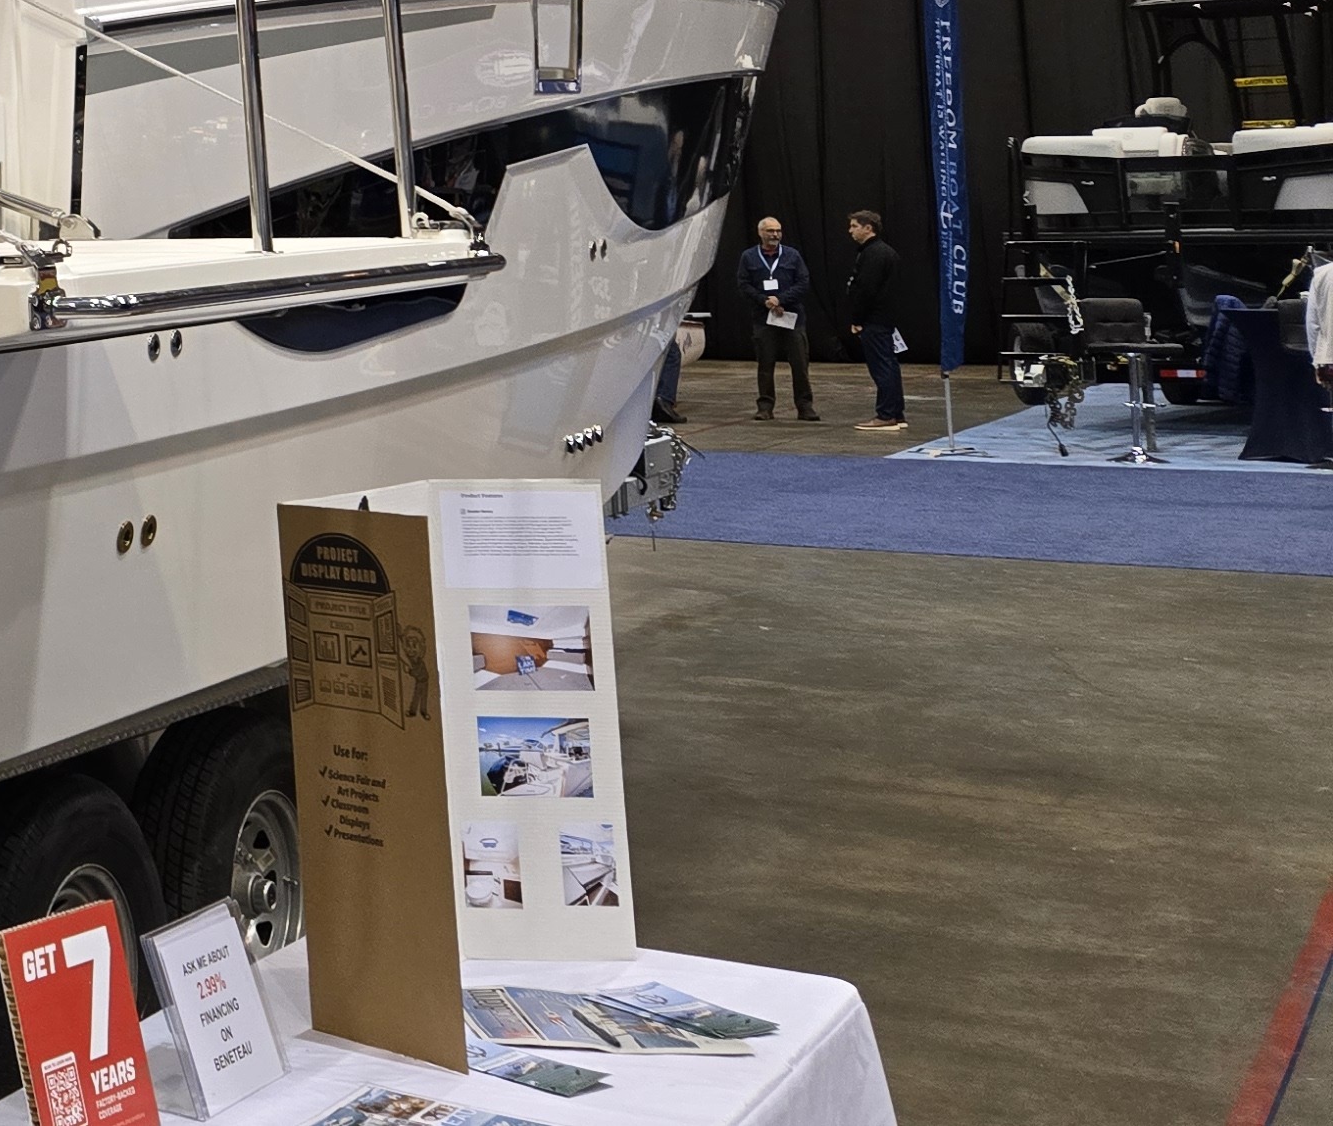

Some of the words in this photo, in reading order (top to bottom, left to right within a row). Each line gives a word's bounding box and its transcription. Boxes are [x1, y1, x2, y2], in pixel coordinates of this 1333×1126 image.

[952, 245, 967, 315] CLUB
[315, 545, 359, 563] PROJECT
[300, 562, 343, 580] DISPLAY
[343, 566, 377, 584] BOARD
[333, 744, 350, 758] Use
[327, 769, 355, 783] Science
[356, 774, 370, 786] Fair
[371, 779, 386, 789] and
[337, 786, 350, 797] Art
[350, 788, 379, 803] Projects
[330, 798, 369, 814] Classroom
[339, 815, 370, 831] Displays
[334, 828, 384, 847] Presentations
[21, 942, 57, 983] GET
[182, 962, 196, 976] ASK
[196, 955, 208, 970] ME
[208, 945, 231, 964] ABOUT
[61, 925, 111, 1061] 7
[196, 972, 227, 1000] 2.99%
[199, 997, 240, 1027] FINANCING
[220, 1025, 234, 1042] ON
[213, 1041, 253, 1071] BENETEAU
[90, 1057, 136, 1095] YEARS
[95, 1085, 136, 1109] FACTORY-BACKED
[98, 1102, 123, 1121] COVERAGE
